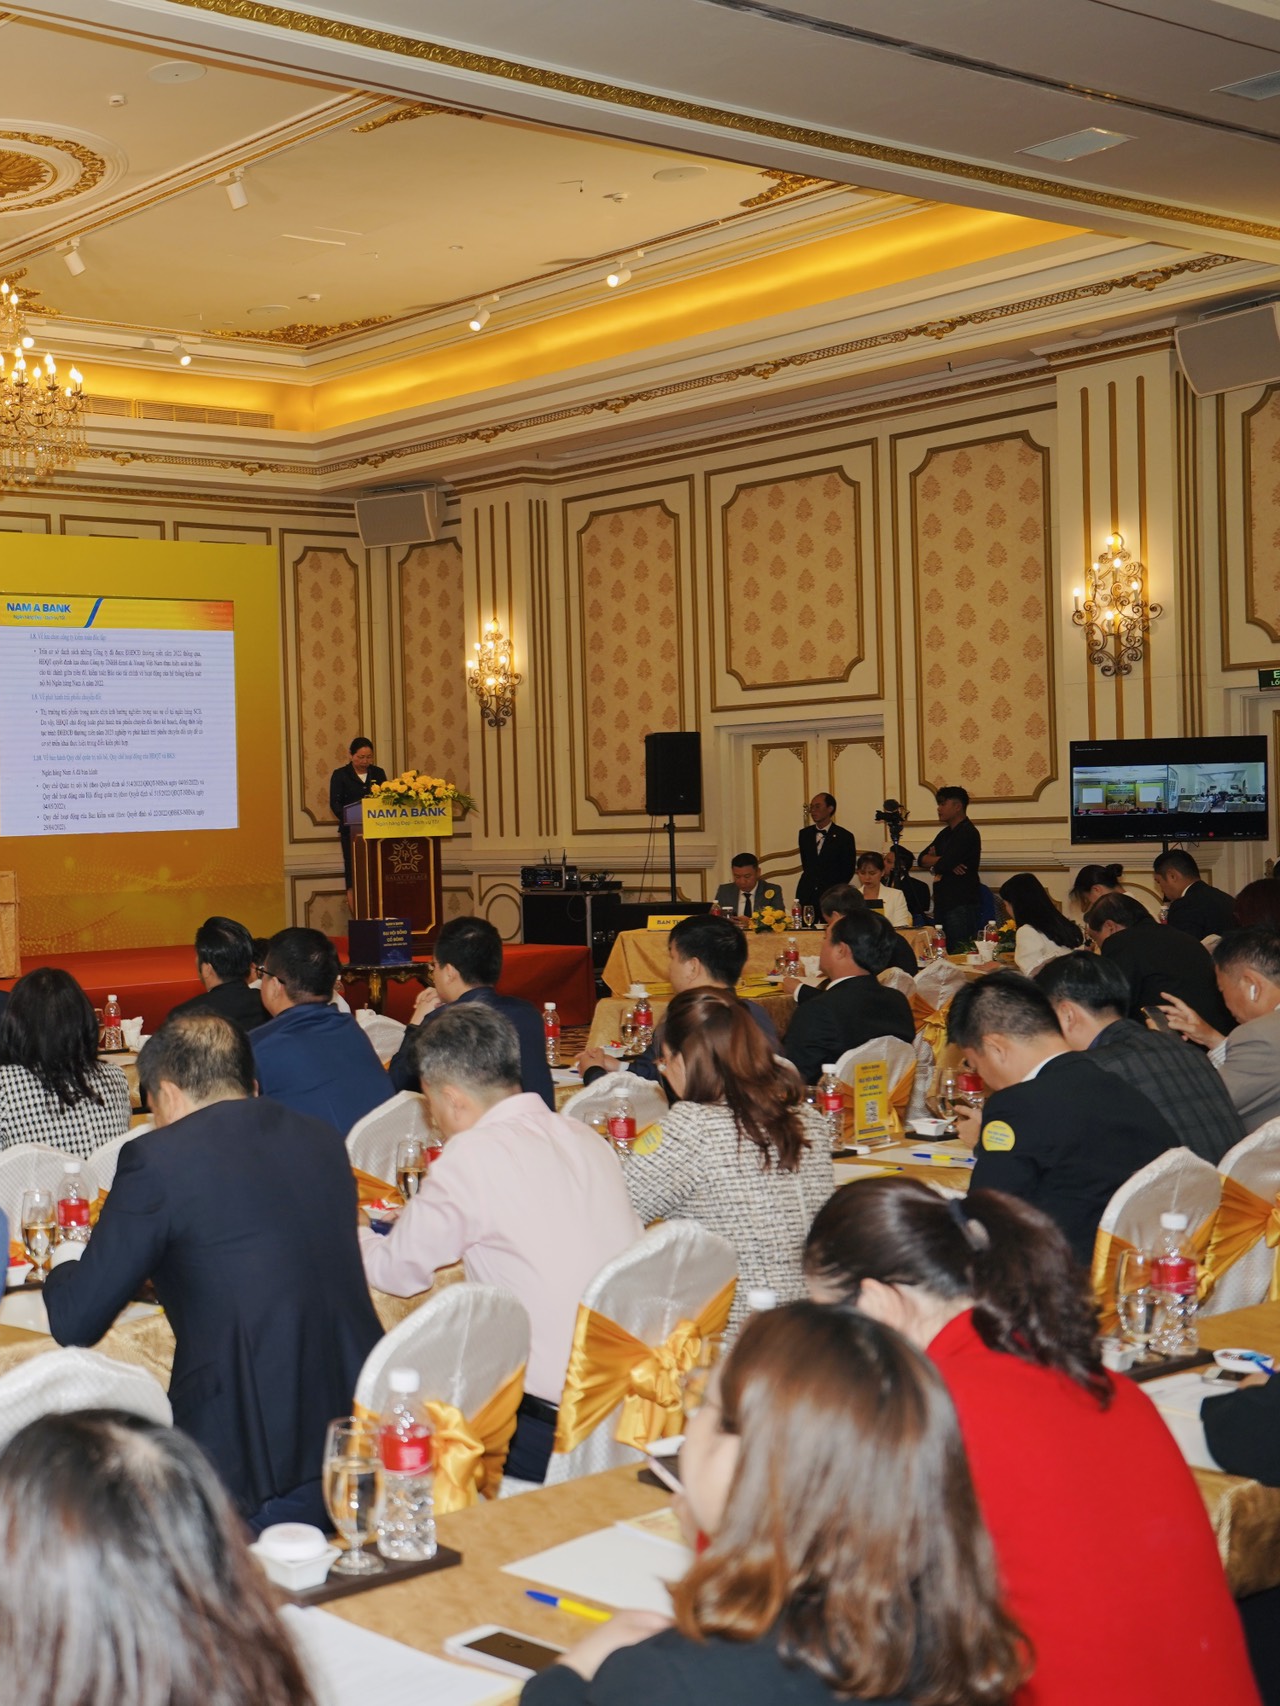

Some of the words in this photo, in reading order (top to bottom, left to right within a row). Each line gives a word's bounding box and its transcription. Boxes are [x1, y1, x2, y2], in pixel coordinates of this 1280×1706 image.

[7, 603, 32, 612] NAM
[34, 604, 40, 612] A
[42, 604, 71, 612] BANK
[368, 809, 397, 818] NAM
[400, 808, 408, 817] A
[411, 808, 446, 817] BANK
